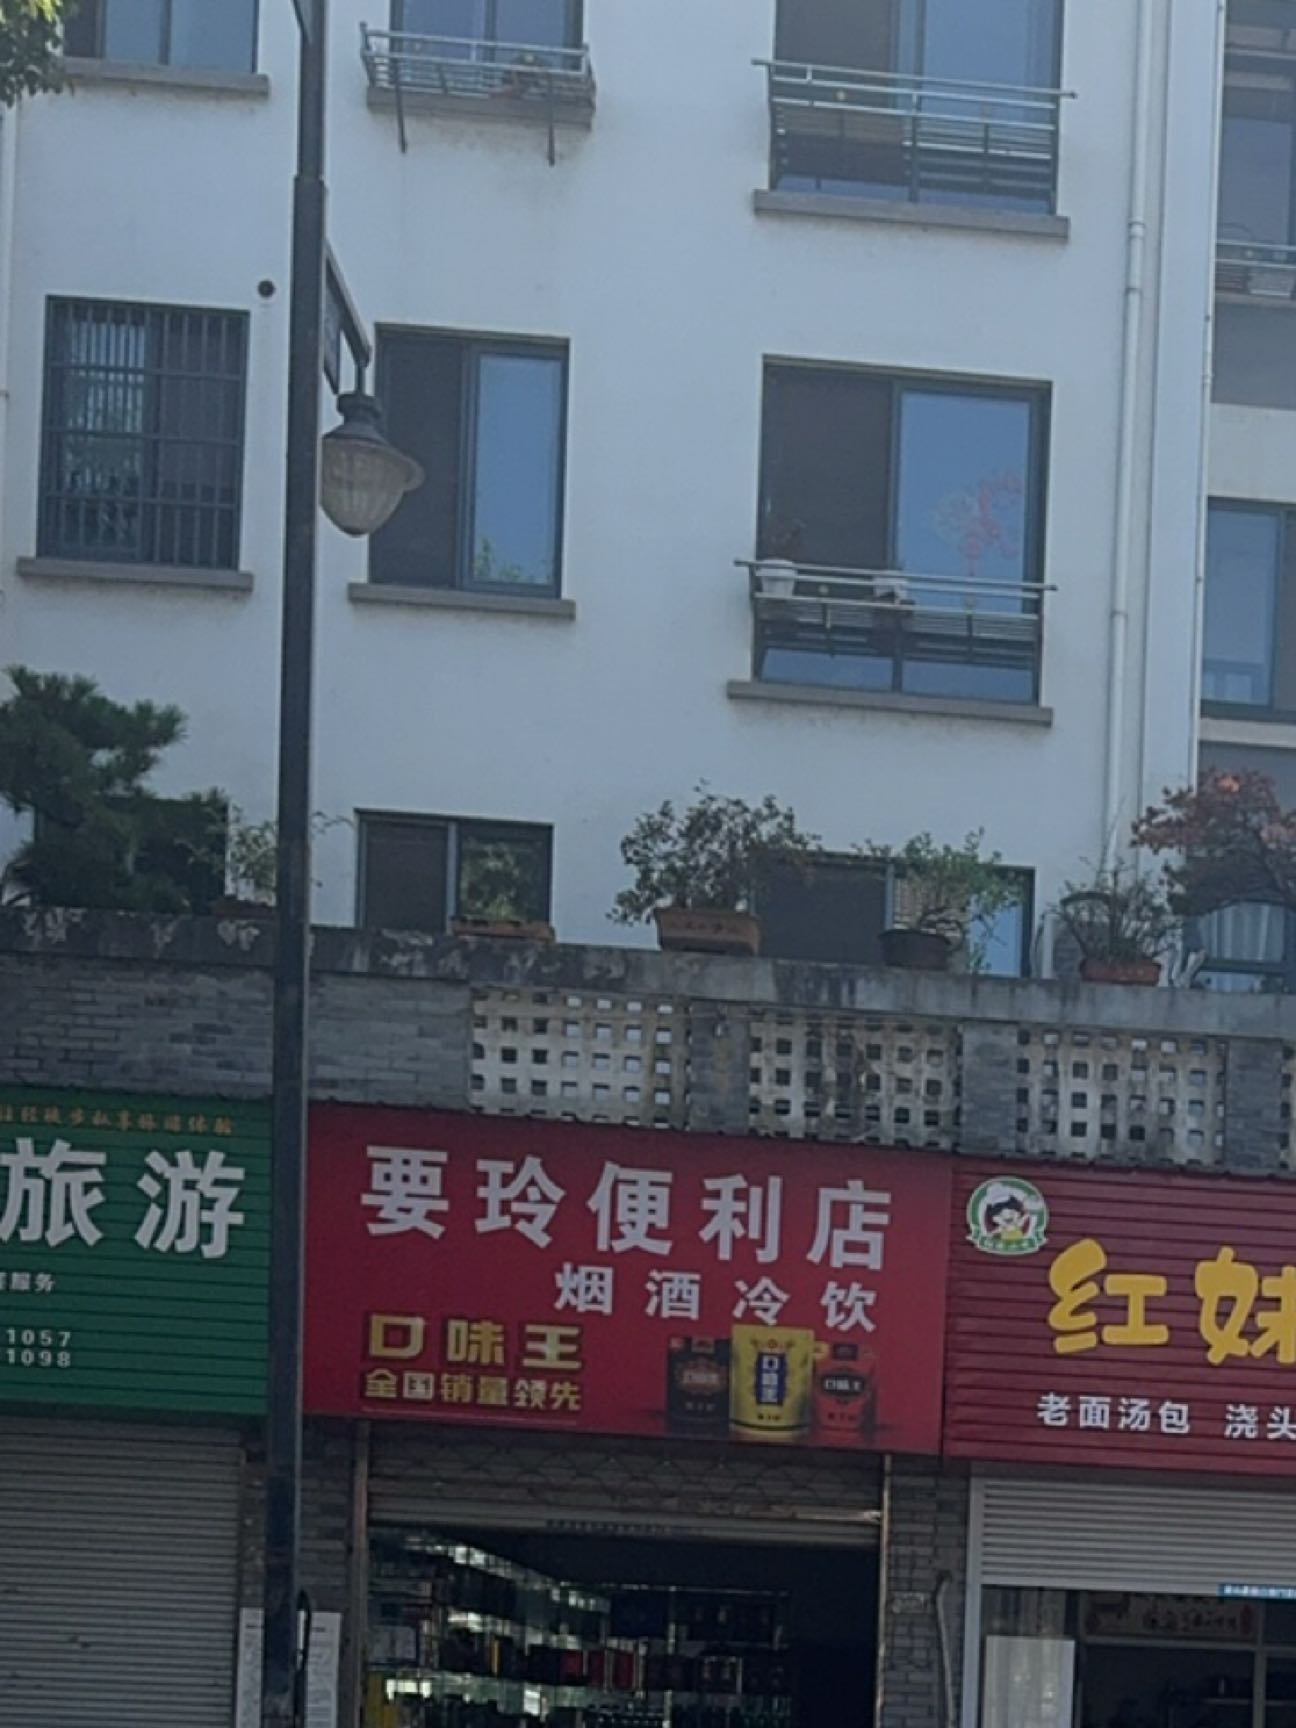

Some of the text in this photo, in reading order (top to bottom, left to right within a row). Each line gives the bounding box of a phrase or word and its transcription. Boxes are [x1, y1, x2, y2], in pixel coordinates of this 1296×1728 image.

[0, 1137, 246, 1258] 旅游
[360, 1144, 892, 1270] 要玲便利店
[554, 1262, 877, 1333] 烟酒冷饮
[368, 1313, 582, 1370] 口味王
[364, 1368, 582, 1411] 全国销量领先
[1036, 1391, 1191, 1435] 老面汤包
